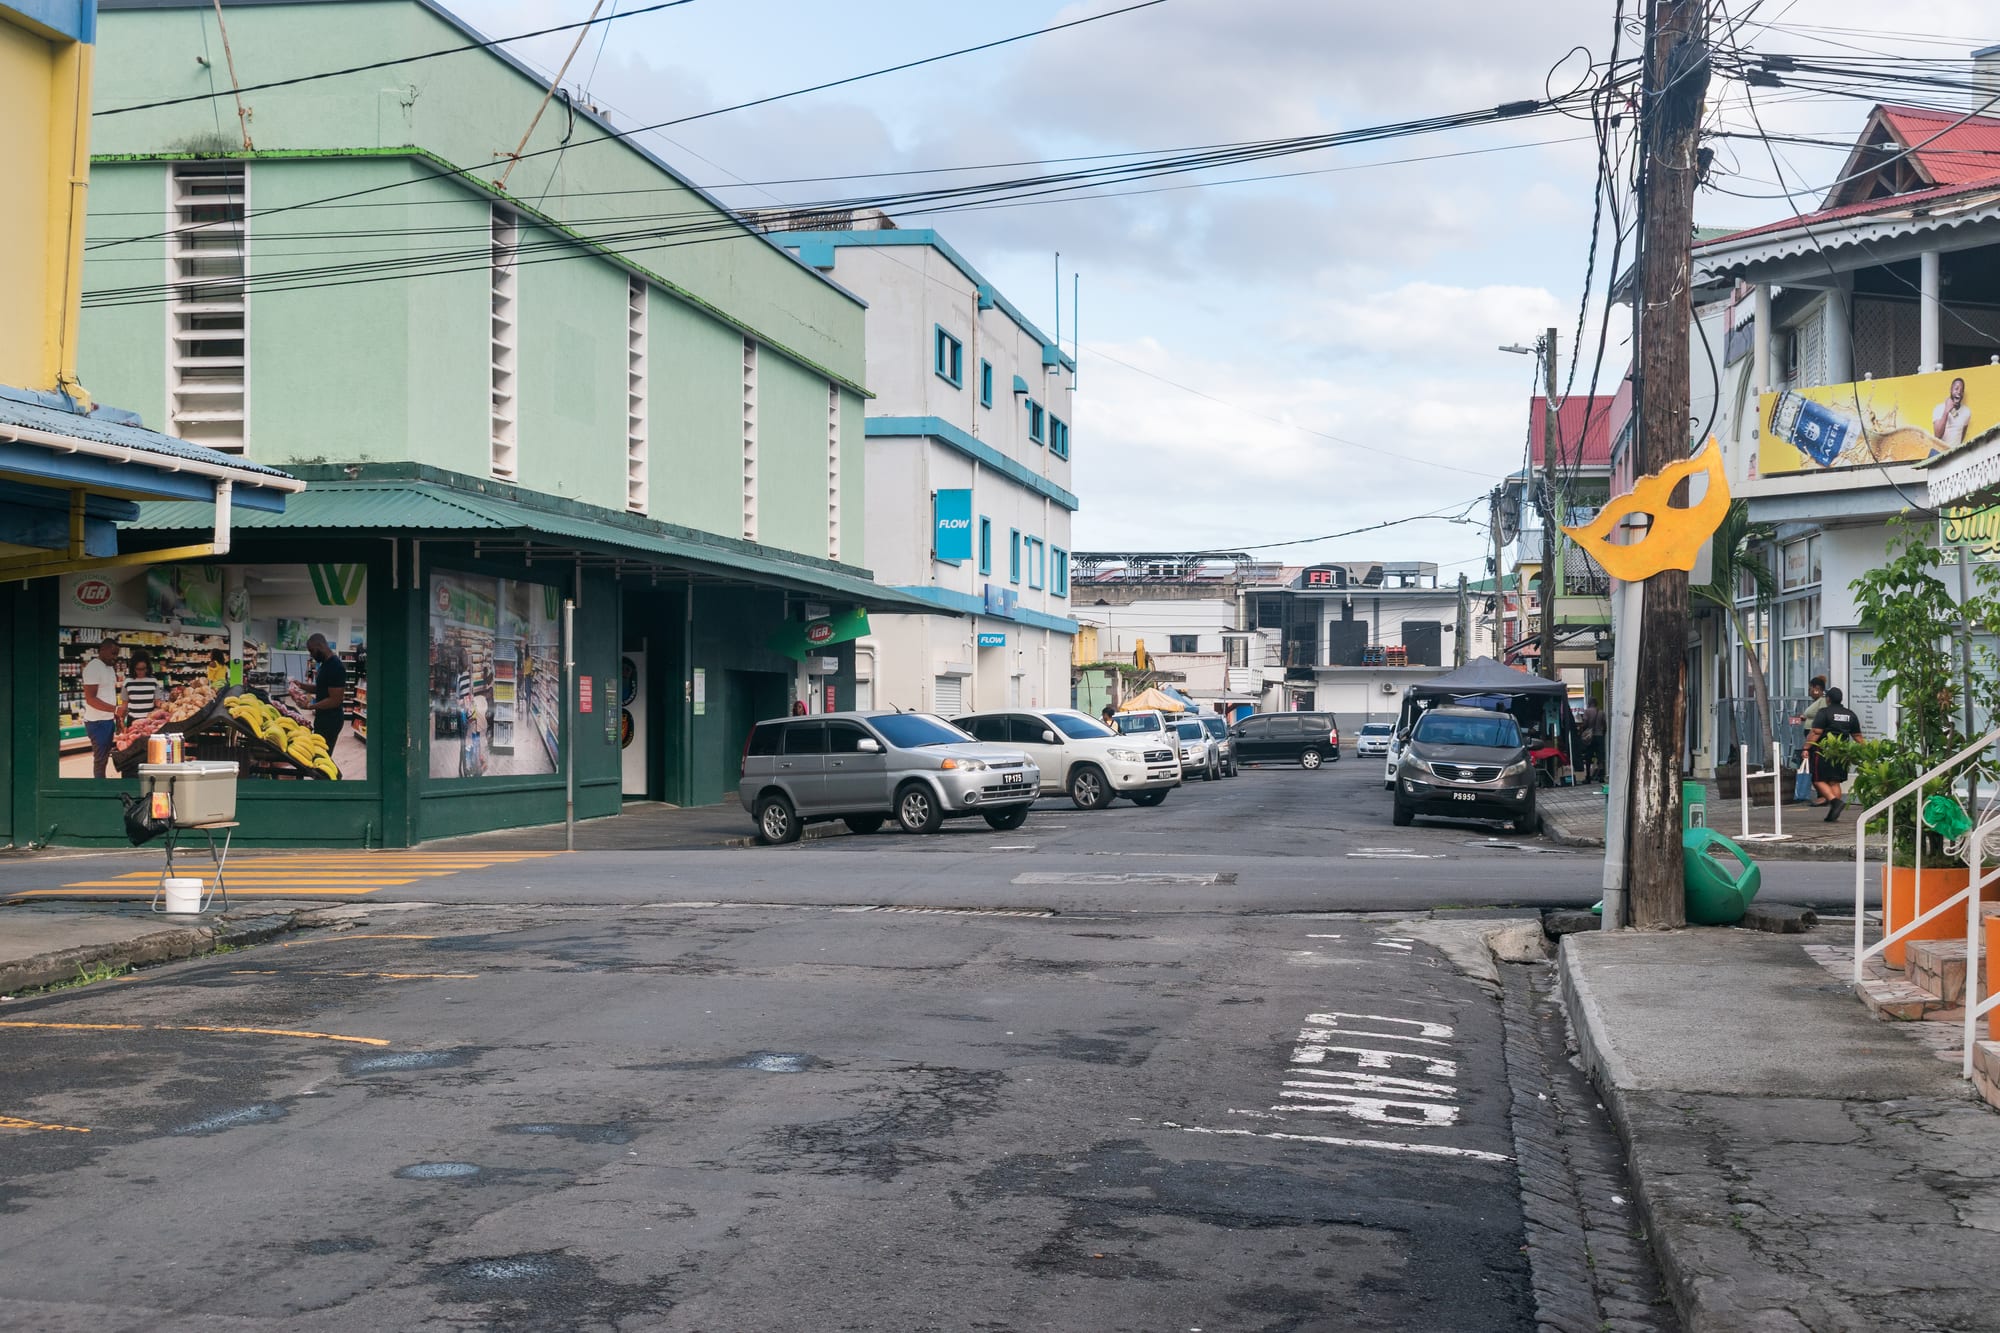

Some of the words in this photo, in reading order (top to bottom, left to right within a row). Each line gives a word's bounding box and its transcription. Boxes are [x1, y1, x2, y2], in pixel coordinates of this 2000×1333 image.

[1822, 423, 1840, 462] LAGER
[939, 519, 969, 529] FLOW
[80, 585, 107, 599] IGA
[811, 626, 829, 639] IGA
[980, 636, 1004, 644] FLOW
[1453, 792, 1476, 801] PS950
